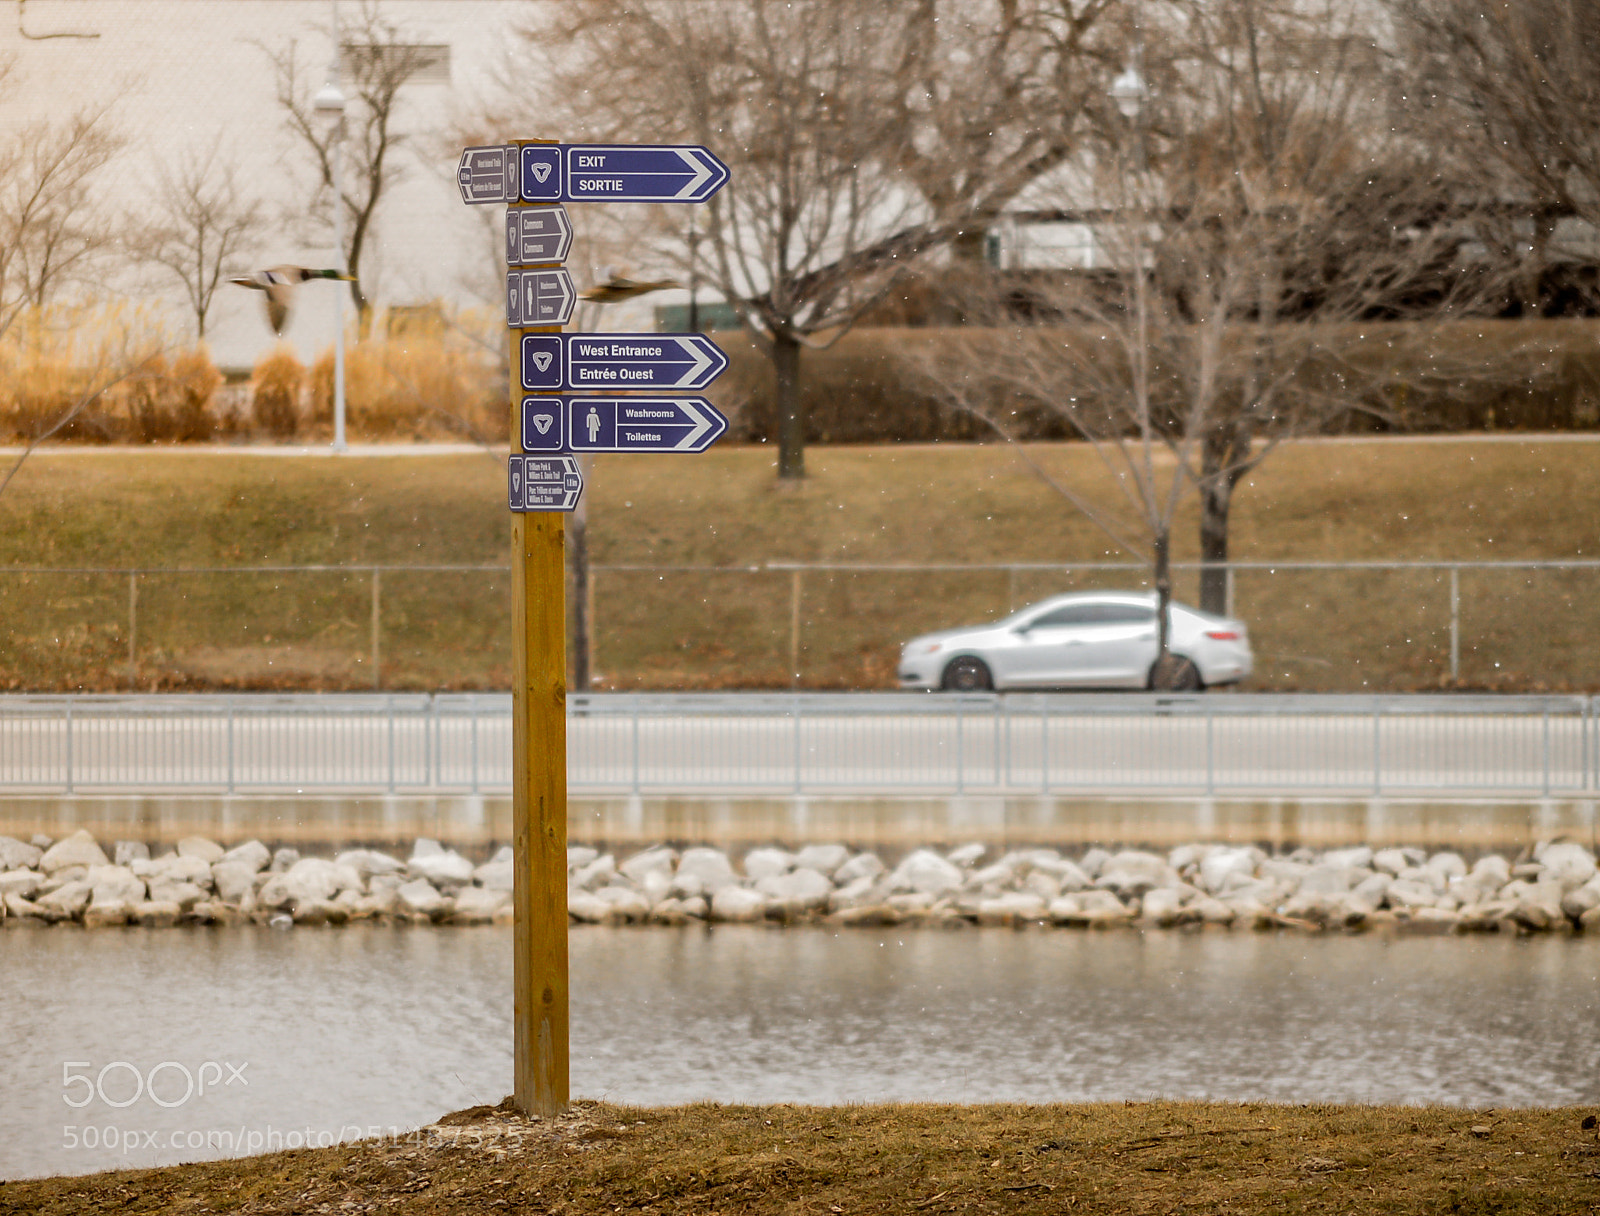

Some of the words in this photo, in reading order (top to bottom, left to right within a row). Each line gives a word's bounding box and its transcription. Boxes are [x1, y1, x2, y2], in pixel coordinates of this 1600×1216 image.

[579, 156, 606, 167] EXIT
[579, 180, 623, 191] SORTIE
[580, 345, 609, 356] West
[611, 345, 662, 356] Entrance
[580, 367, 617, 379] Entrée
[620, 369, 654, 379] Ouest
[625, 409, 674, 418] Washrooms
[625, 432, 661, 441] Toilettes
